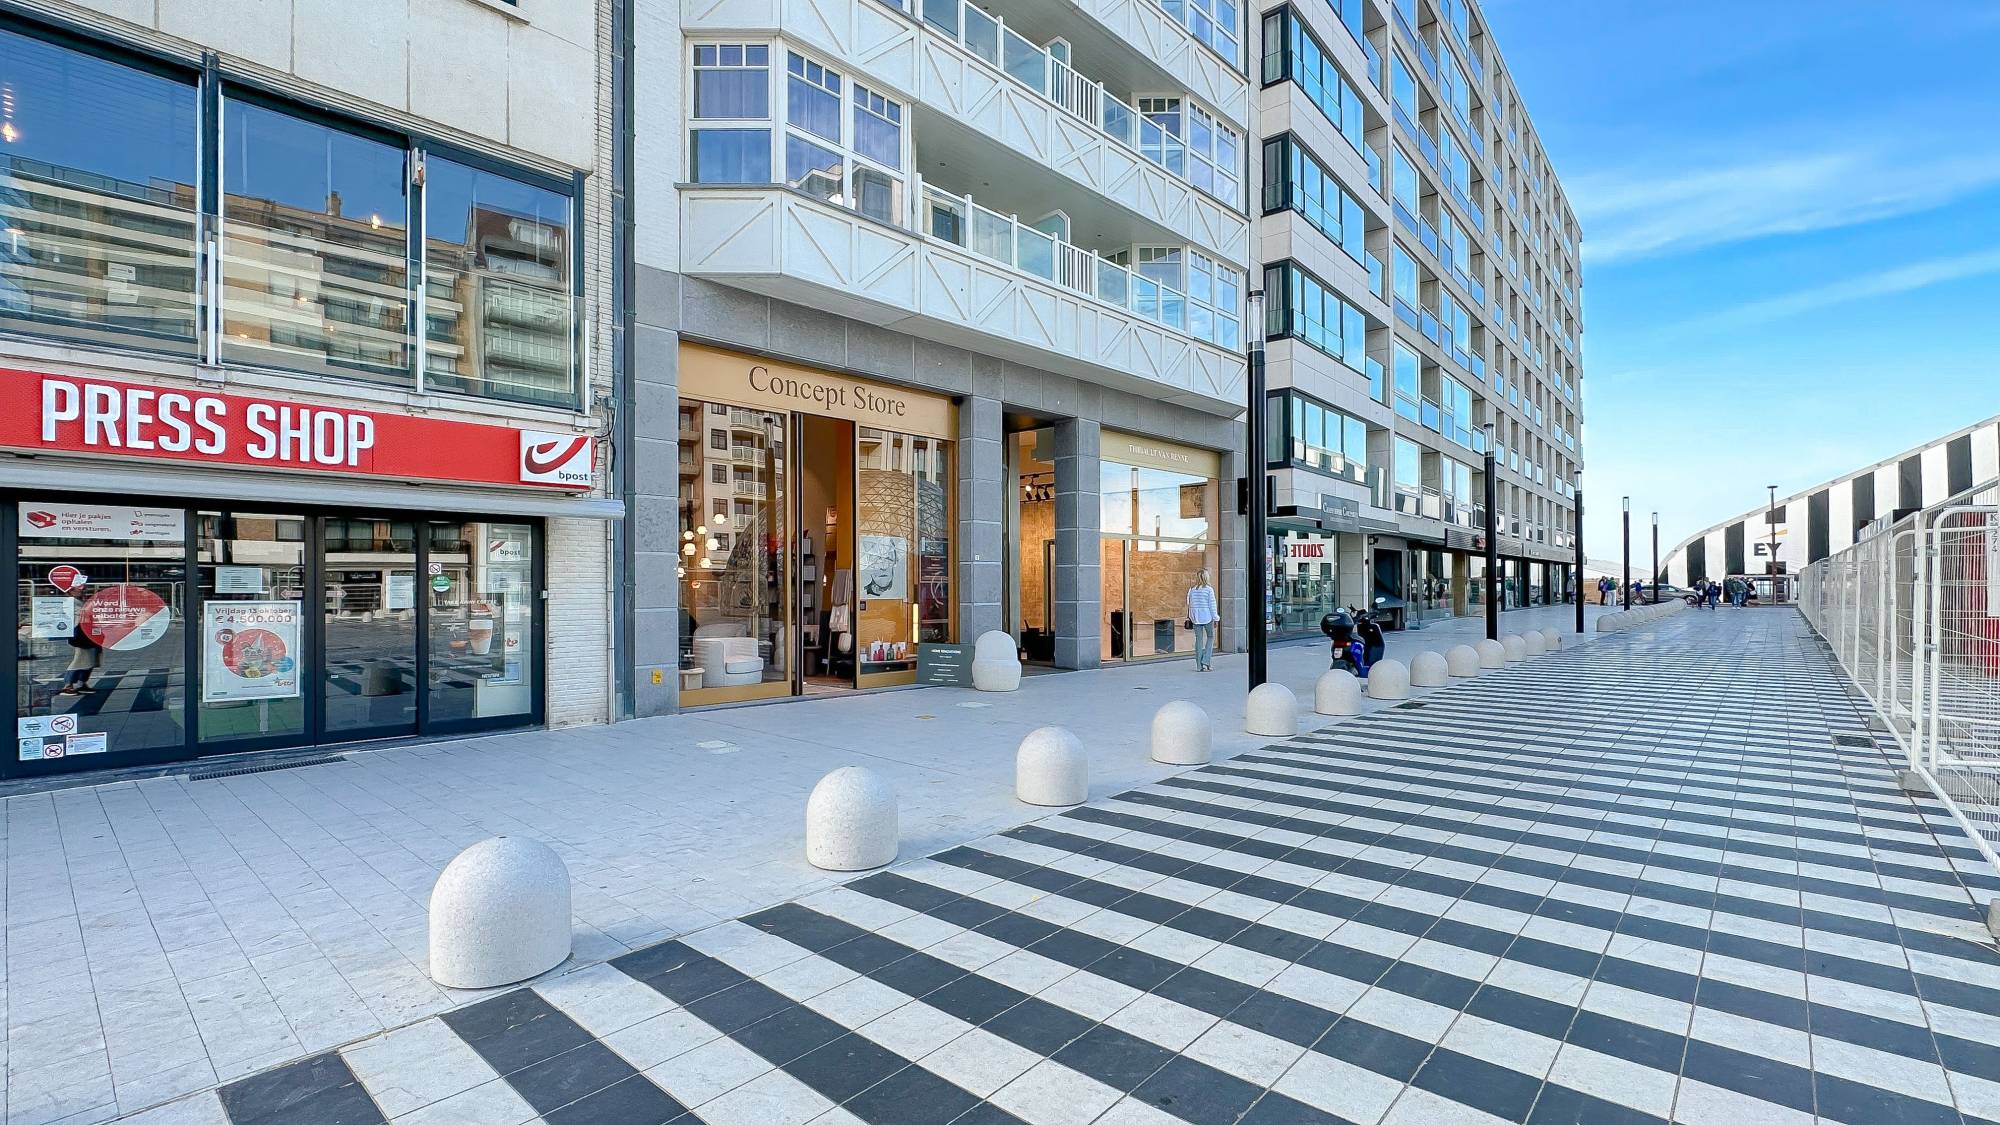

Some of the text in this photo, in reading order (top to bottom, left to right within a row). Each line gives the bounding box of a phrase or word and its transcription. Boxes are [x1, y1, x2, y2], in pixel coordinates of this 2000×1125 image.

[748, 366, 906, 417] Concept Store
[42, 379, 374, 467] PRESS SHOP
[558, 470, 588, 481] bpost
[1753, 542, 1782, 557] EY
[215, 608, 246, 616] Vrijdag
[226, 615, 292, 623] 4.500.000
